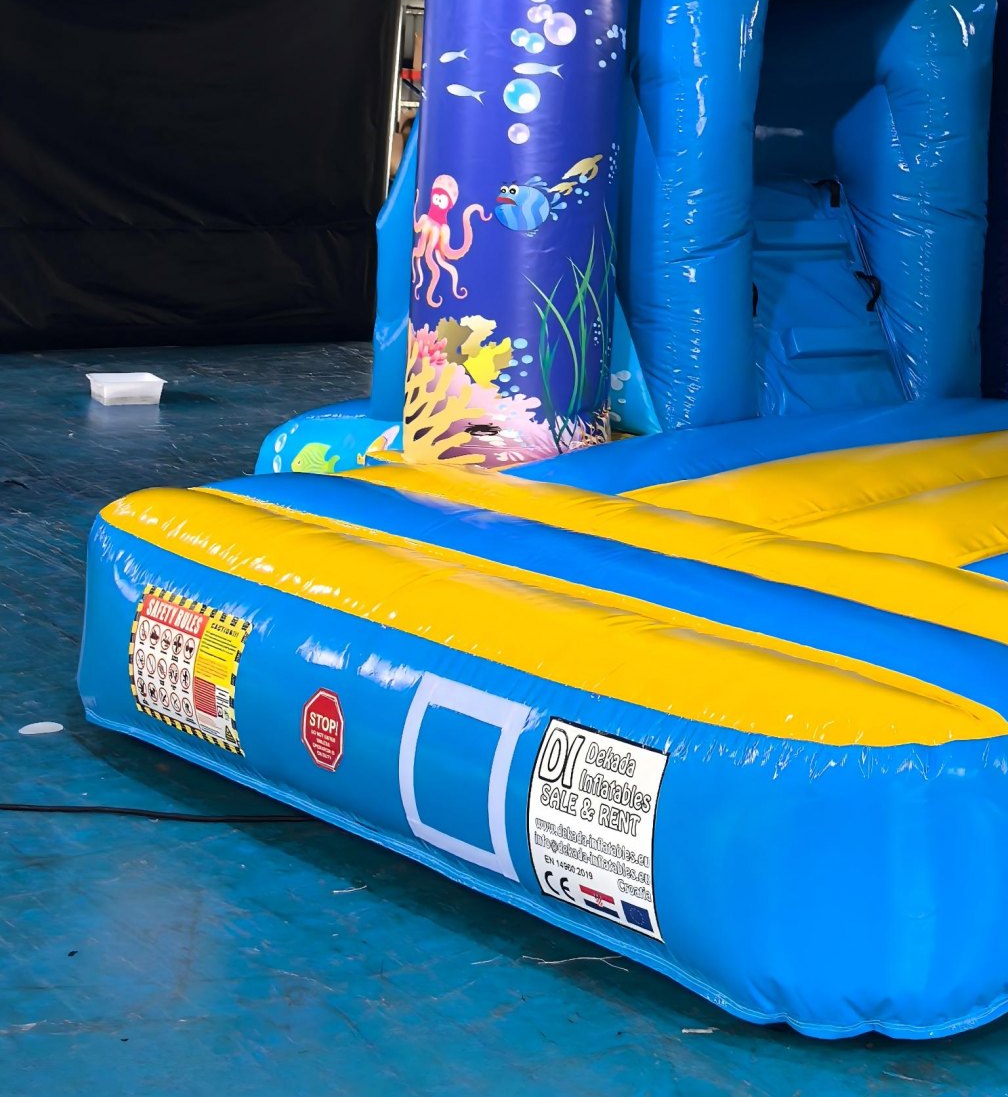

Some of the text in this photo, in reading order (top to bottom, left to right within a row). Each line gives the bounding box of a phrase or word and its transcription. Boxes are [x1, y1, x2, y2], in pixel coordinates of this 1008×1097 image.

[146, 598, 203, 634] SAFETY RULES
[309, 711, 339, 736] STOP!
[585, 742, 636, 778] Dekada
[578, 769, 652, 813] Inflatables
[540, 783, 641, 837] SALE & RENT
[544, 854, 555, 865] EN
[576, 867, 593, 879] 2019
[617, 879, 652, 902] Croatia
